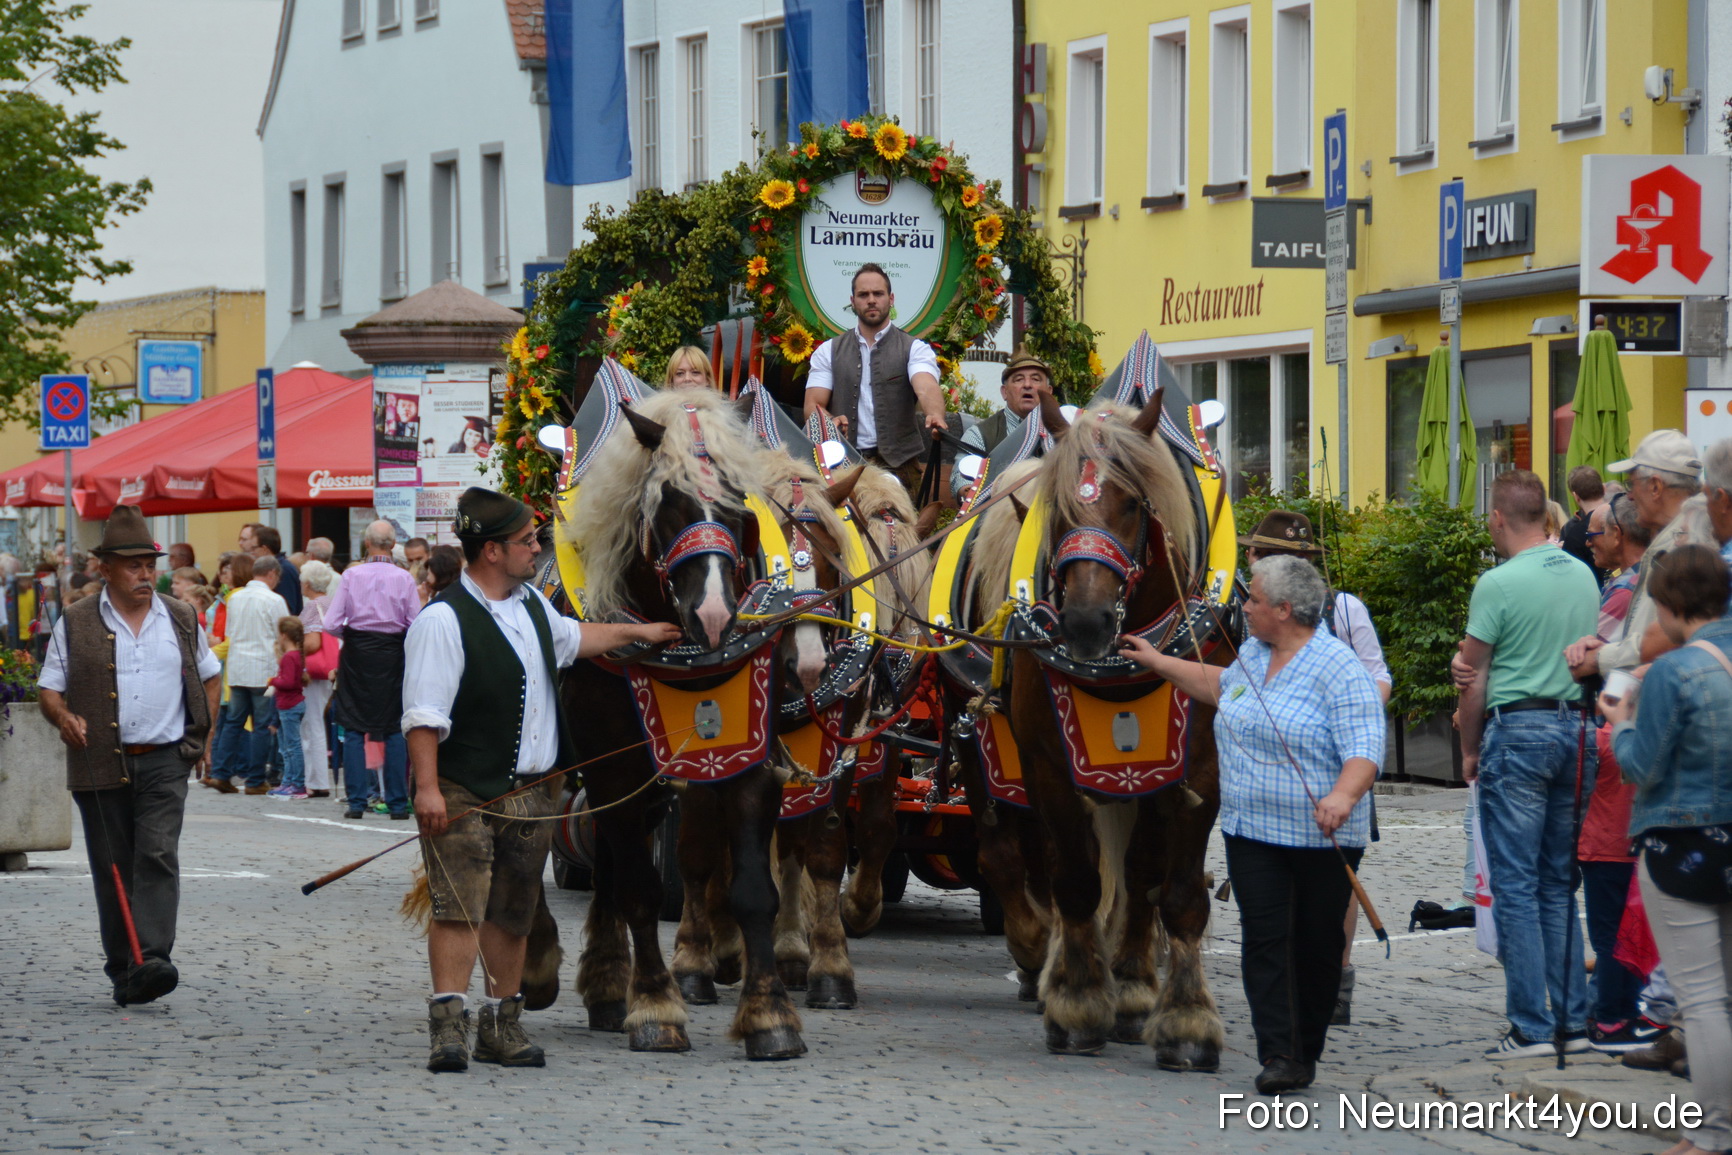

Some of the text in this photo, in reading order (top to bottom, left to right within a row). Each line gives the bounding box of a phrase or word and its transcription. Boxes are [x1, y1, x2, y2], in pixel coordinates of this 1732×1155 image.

[1328, 127, 1342, 198] P
[828, 211, 920, 227] Neumarkter
[1463, 202, 1516, 249] IFUN
[810, 226, 935, 249] Lammsbräu
[1443, 195, 1458, 268] P
[1260, 242, 1350, 259] TAIFU
[888, 261, 911, 269] leben.
[1159, 274, 1264, 326] Restaurant
[259, 377, 271, 430] P
[46, 426, 86, 442] TAXI
[307, 470, 375, 498] Glossner
[416, 492, 451, 500] SOMMER
[427, 500, 449, 508] PARK
[416, 508, 458, 516] EXTRA 201
